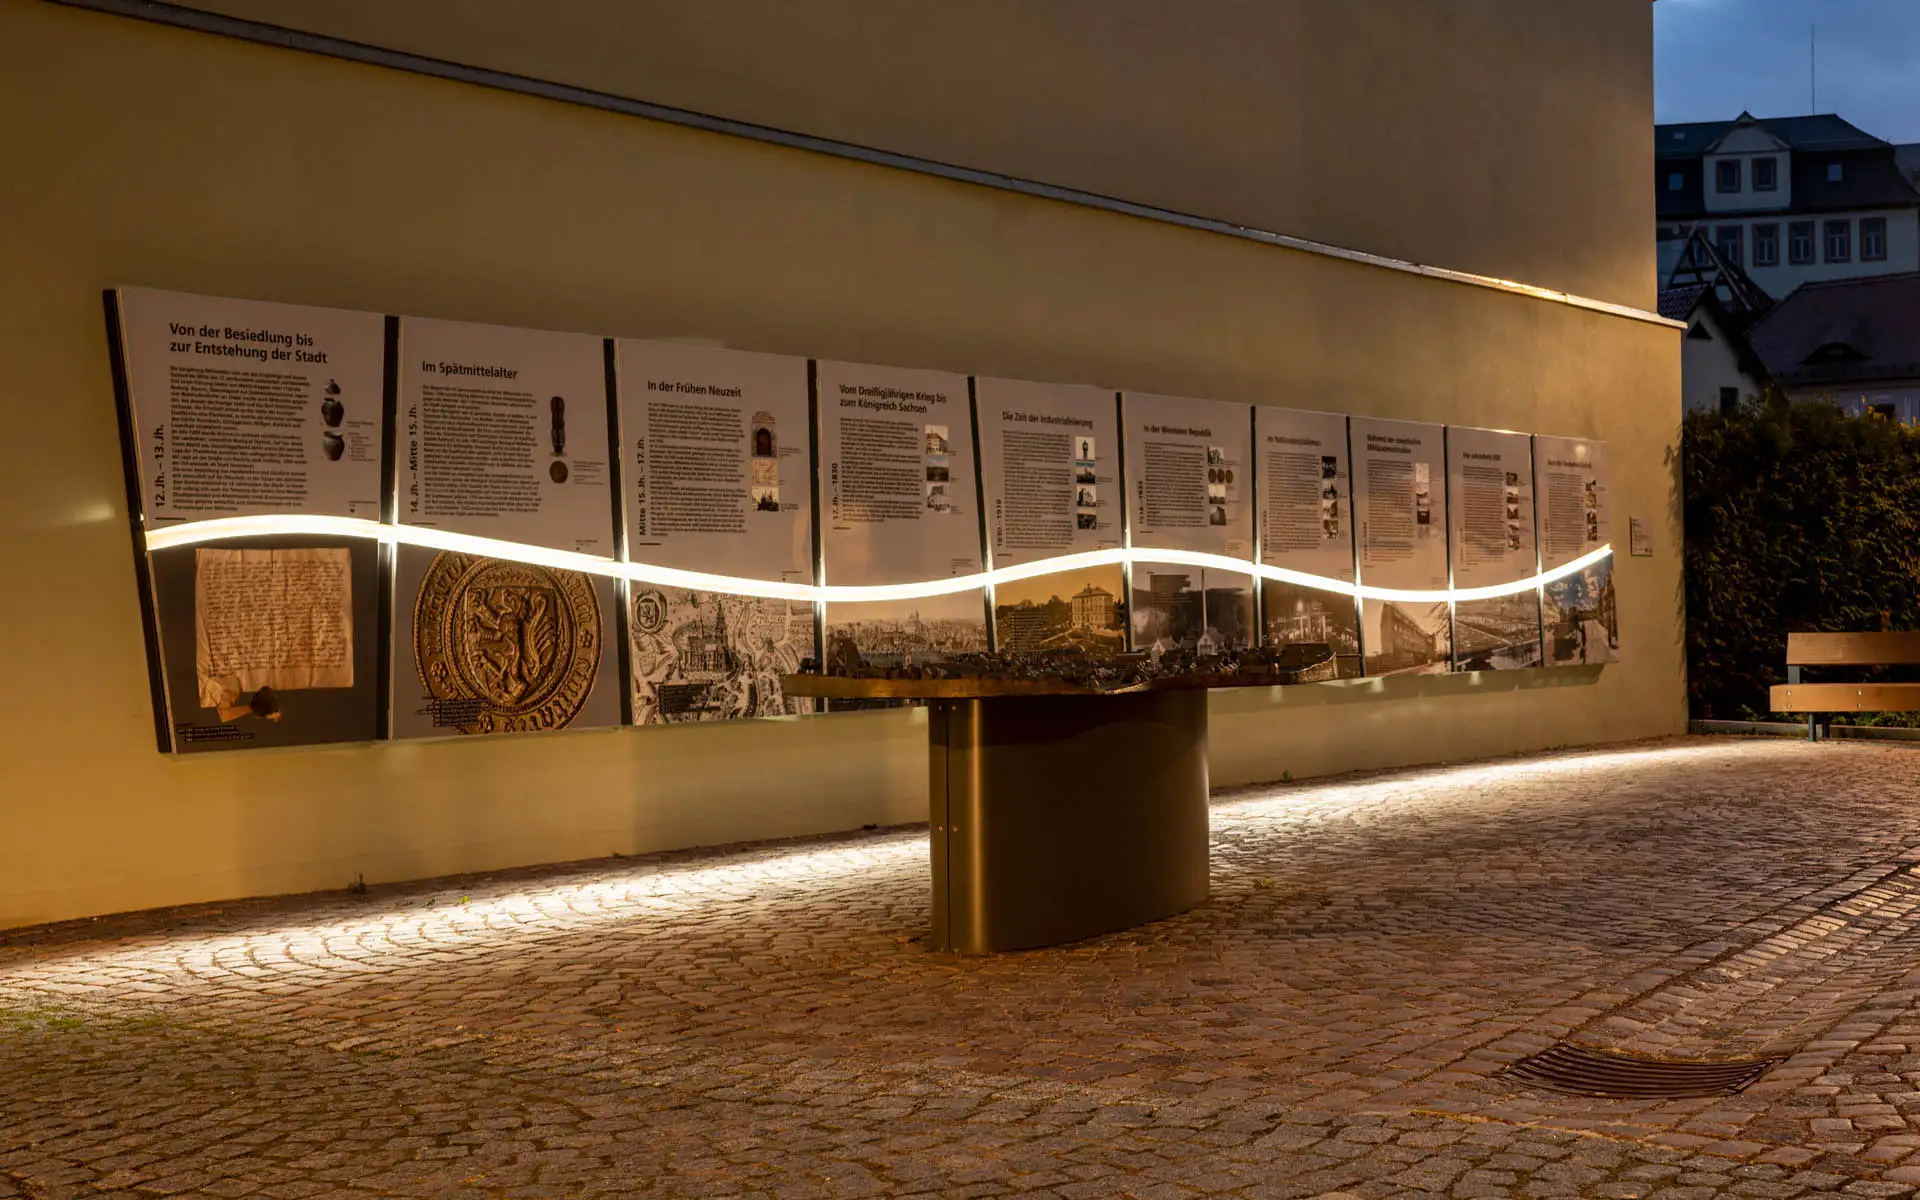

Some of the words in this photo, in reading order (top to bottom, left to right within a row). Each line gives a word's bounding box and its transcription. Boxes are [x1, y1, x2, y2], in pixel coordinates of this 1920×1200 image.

[169, 322, 195, 337] Von
[199, 325, 221, 338] der
[224, 327, 293, 347] Besiedlung
[296, 333, 314, 347] bis
[169, 341, 192, 353] zur
[195, 341, 268, 362] Entstehung
[271, 348, 292, 361] der
[295, 350, 328, 364] Stadt
[422, 360, 436, 373] Im
[439, 361, 518, 380] Spätmittelalter
[647, 380, 657, 391] In
[659, 381, 674, 392] der
[676, 382, 707, 395] Frühen
[708, 385, 743, 398] Neuzeit
[839, 384, 857, 395] Vom
[916, 391, 936, 404] Krieg
[937, 393, 948, 403] bis
[839, 399, 857, 408] zum
[858, 399, 898, 412] Königreich
[899, 402, 928, 414] Sachsen
[1002, 411, 1014, 422] Die
[1014, 412, 1028, 423] Zeit
[1028, 413, 1040, 424] der
[1040, 414, 1094, 430] Industrialisierung
[409, 440, 418, 471] Mitte
[638, 508, 647, 536] Mitte
